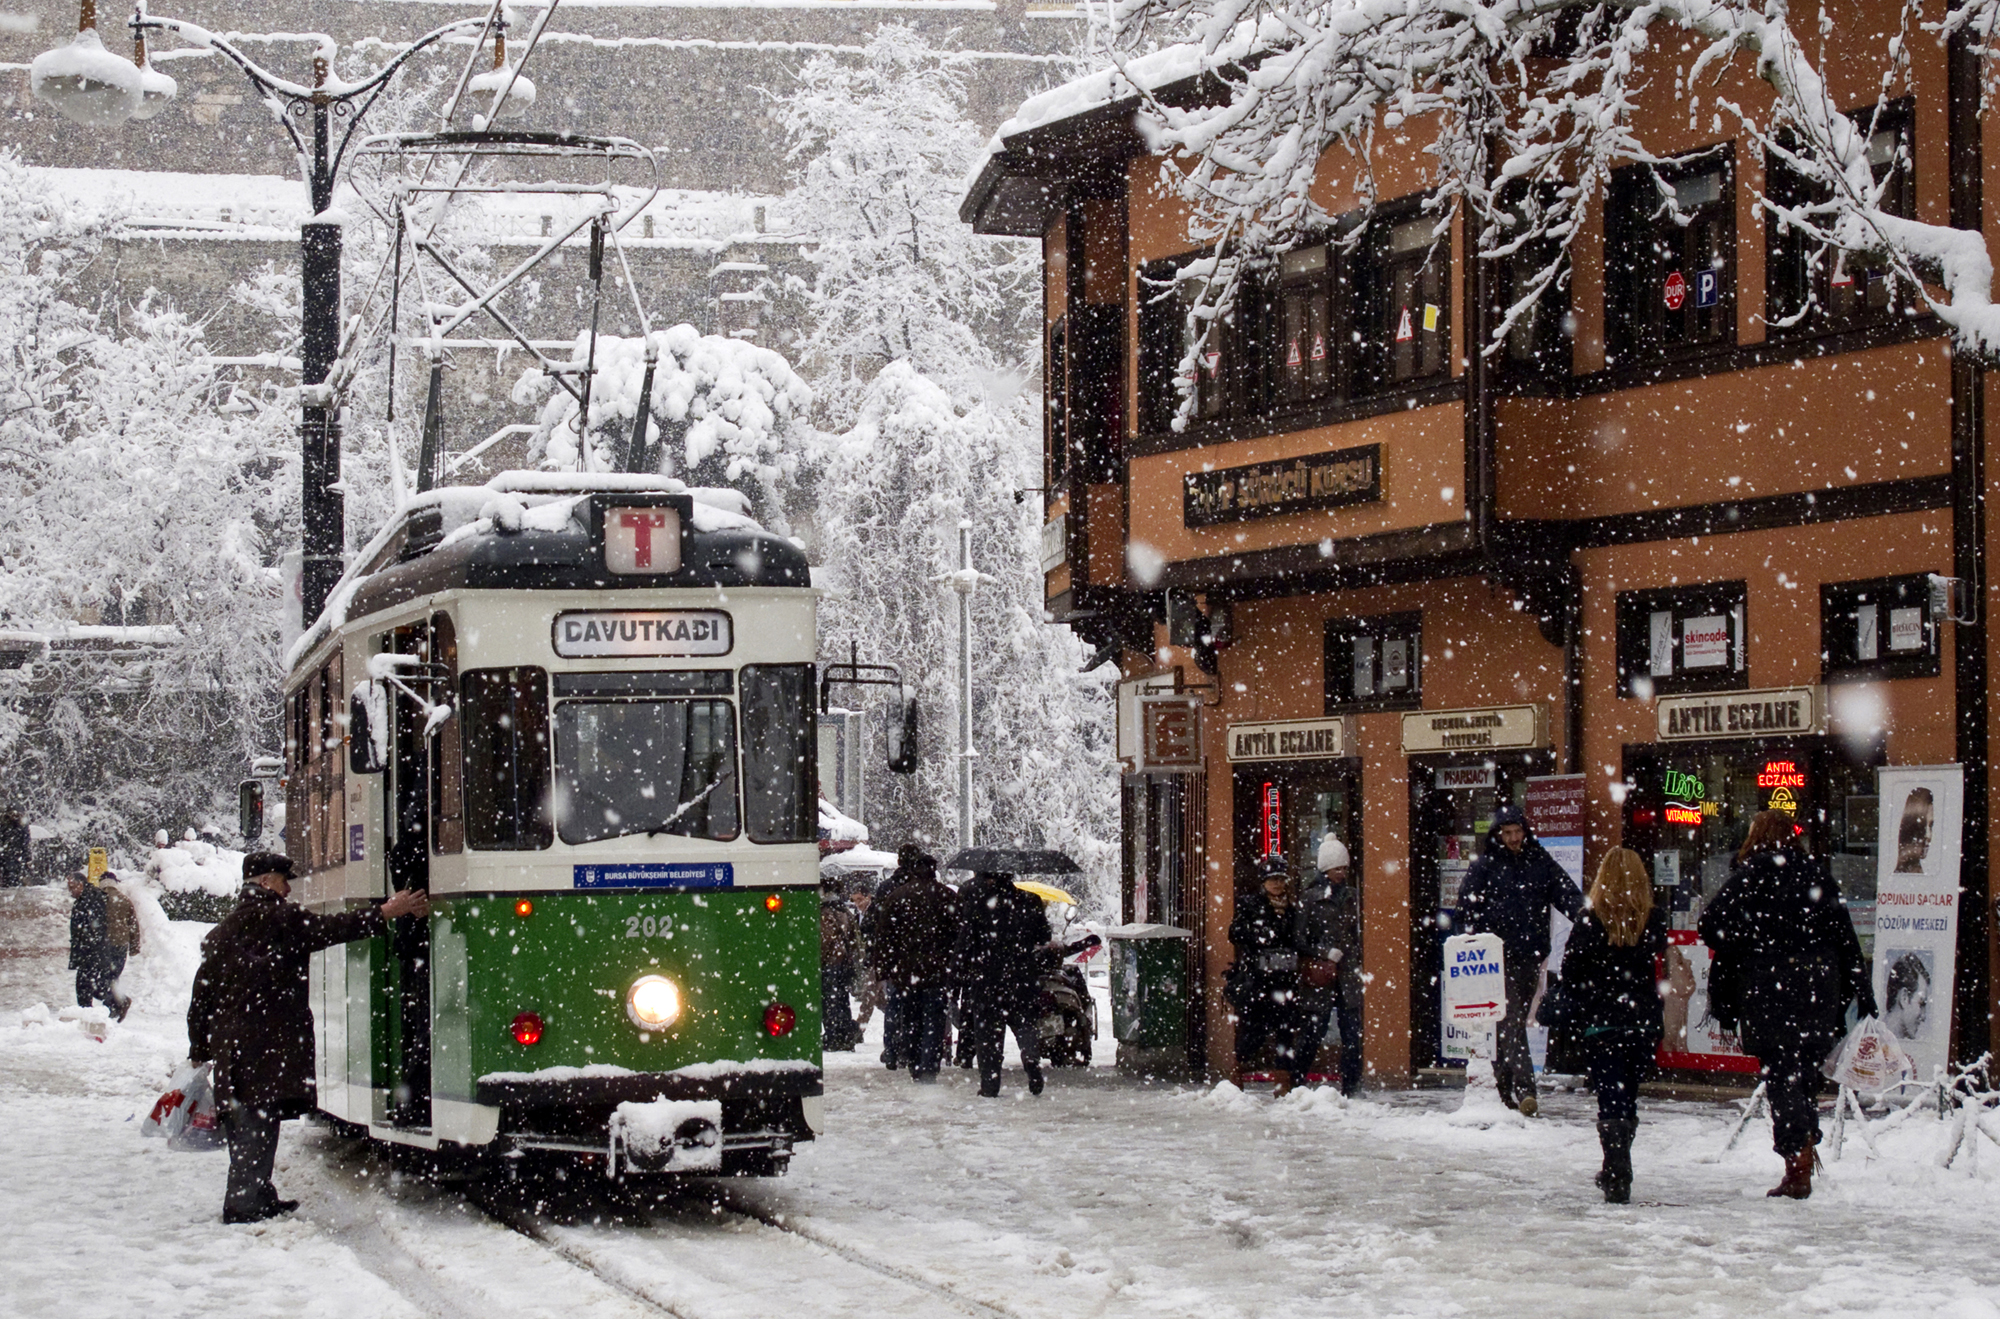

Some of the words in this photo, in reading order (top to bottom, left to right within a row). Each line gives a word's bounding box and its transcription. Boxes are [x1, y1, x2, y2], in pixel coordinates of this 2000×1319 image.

[1667, 284, 1683, 298] DUR
[1702, 274, 1714, 303] P
[620, 514, 665, 568] T
[565, 619, 719, 642] DAVUTKADI
[1685, 628, 1727, 644] skincode
[1668, 700, 1723, 734] ANTİK
[1727, 700, 1800, 731] ECZANE
[1235, 727, 1276, 756] ANTİK
[1279, 729, 1335, 754] ECZANE
[1444, 769, 1489, 786] PHARMACY
[1758, 774, 1805, 786] ECZANE
[1768, 801, 1797, 810] SOLGAR
[1665, 809, 1702, 824] VITAMINS
[604, 872, 627, 880] BURSA
[628, 870, 668, 880] BÜYÜKŞEHİR
[669, 869, 706, 879] BELEDİYESİ
[1877, 893, 1915, 905] SORUNLU
[625, 915, 673, 938] 202
[1877, 914, 1910, 932] ÇÖZÜM
[1912, 915, 1948, 931] MERKEZİ
[1456, 949, 1487, 963] BAY
[1450, 962, 1500, 978] BAYAN
